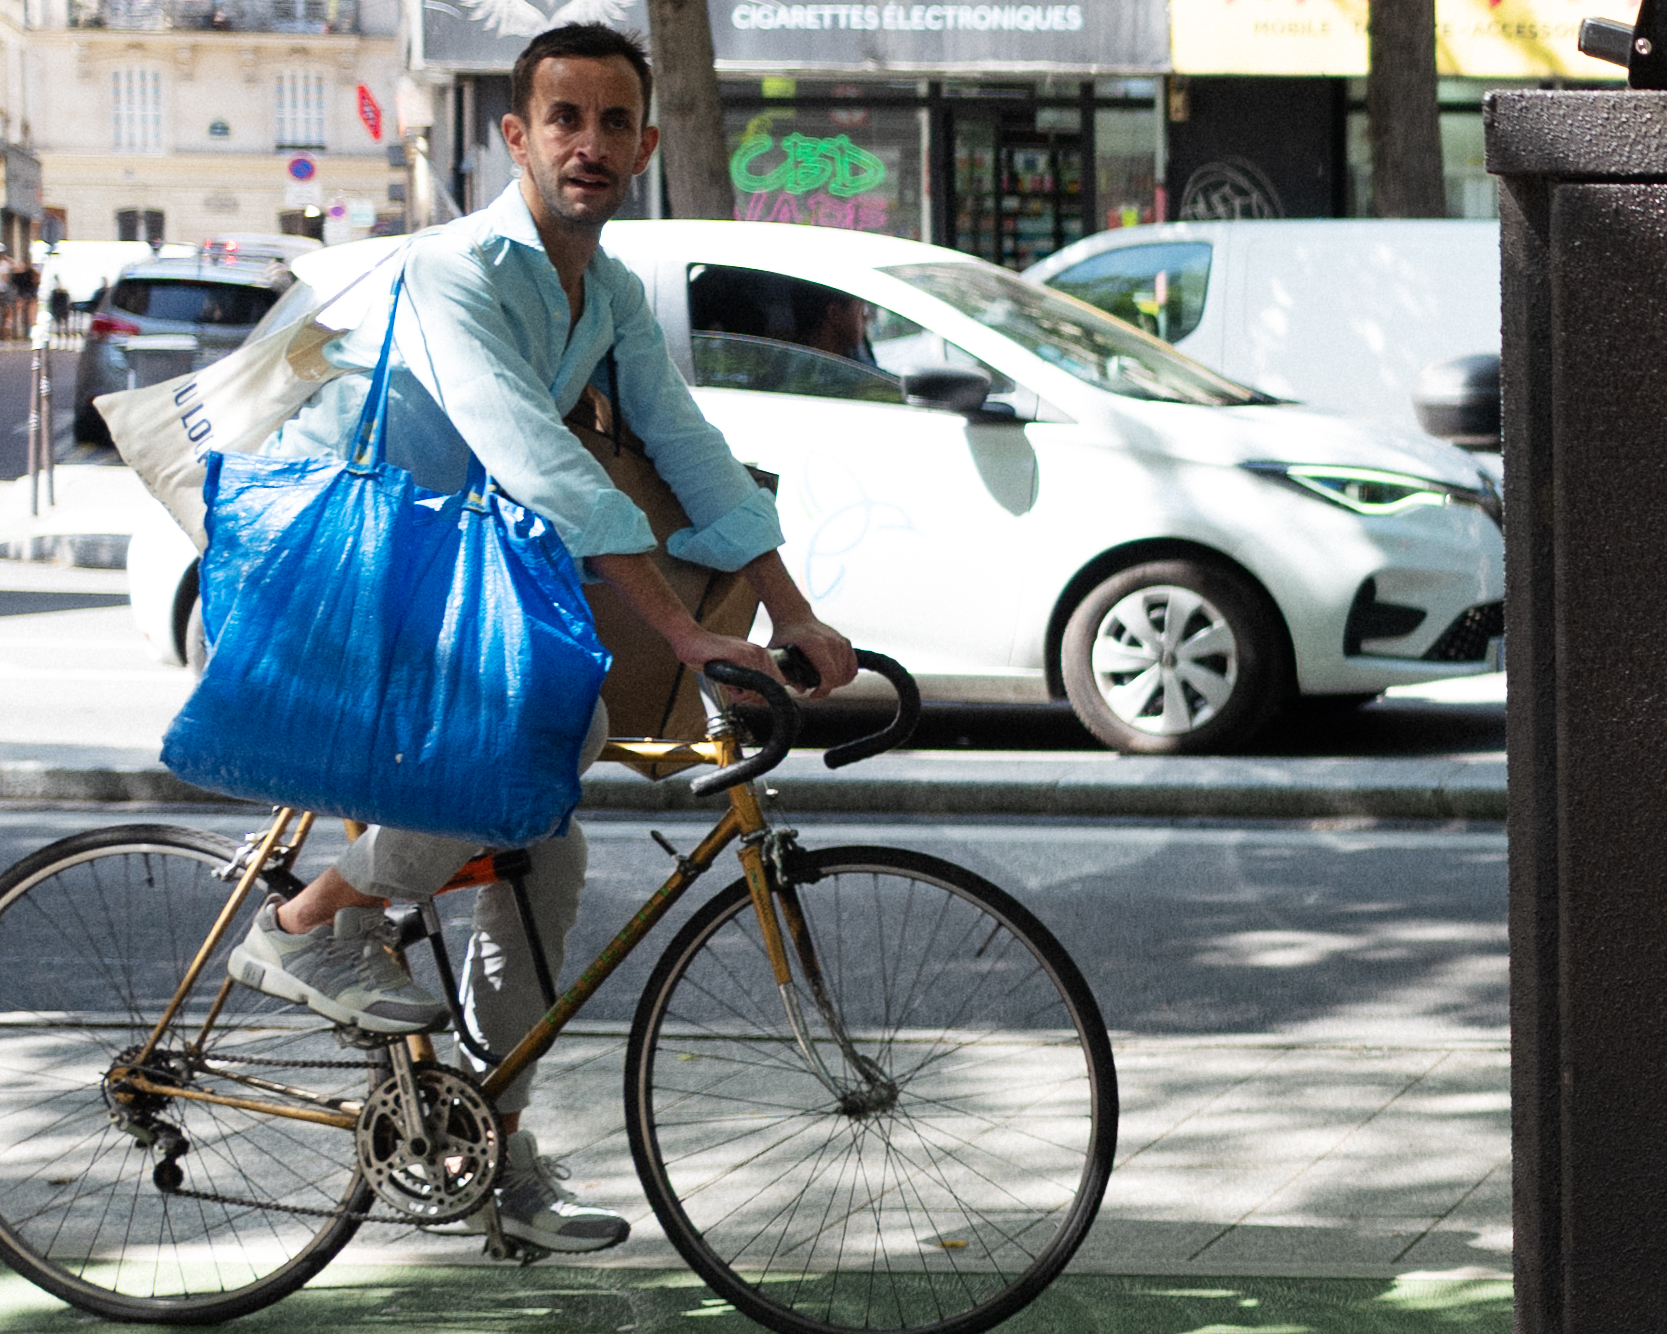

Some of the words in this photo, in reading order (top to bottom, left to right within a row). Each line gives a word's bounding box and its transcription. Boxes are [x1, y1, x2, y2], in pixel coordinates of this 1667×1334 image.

[731, 4, 879, 30] CIGARETTES
[883, 0, 1083, 31] ÉLECTRONIQUES
[730, 131, 886, 197] CBD
